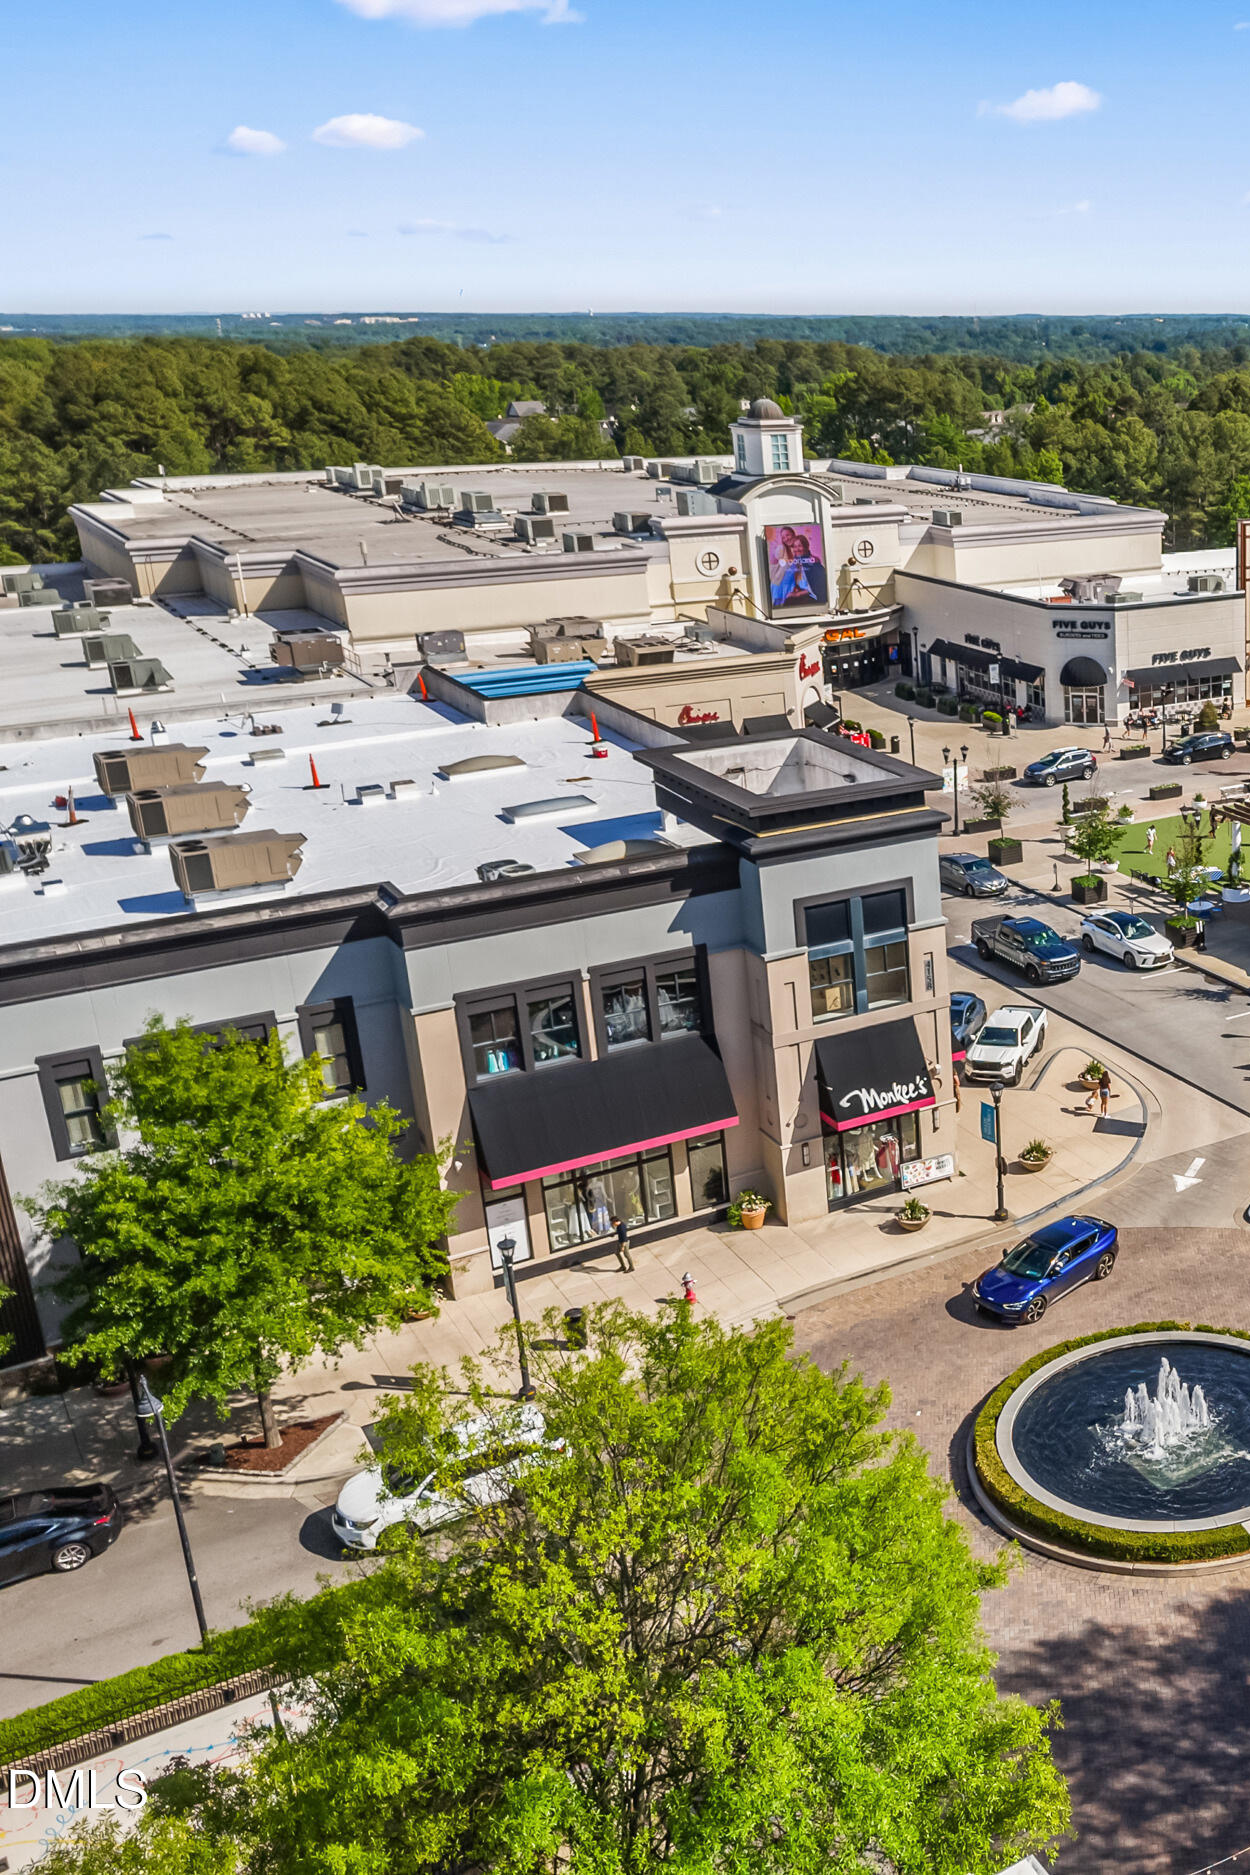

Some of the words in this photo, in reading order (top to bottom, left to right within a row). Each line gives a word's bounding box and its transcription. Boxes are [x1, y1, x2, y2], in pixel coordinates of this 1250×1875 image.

[1052, 620, 1077, 629] FIVE
[1080, 620, 1111, 630] GUYS
[821, 627, 866, 642] GAL
[1152, 651, 1178, 665] FIVE
[1180, 647, 1211, 661] GUYS
[839, 1074, 927, 1113] Monkee's
